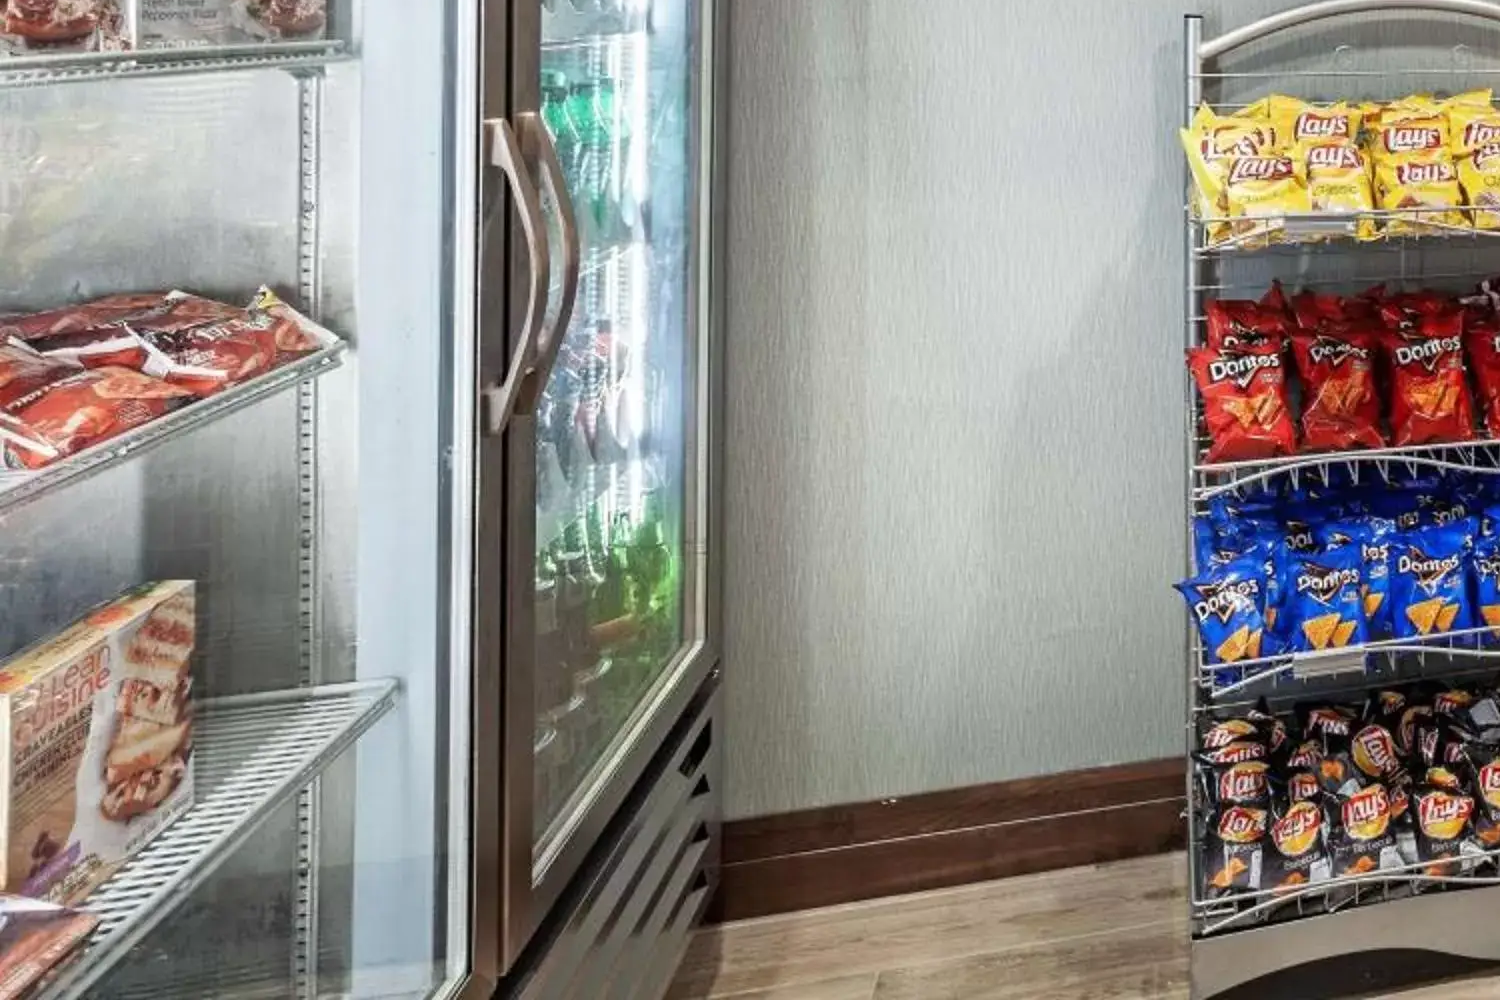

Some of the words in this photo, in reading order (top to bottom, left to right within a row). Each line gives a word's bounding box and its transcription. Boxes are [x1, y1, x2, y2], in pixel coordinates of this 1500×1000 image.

[1297, 112, 1348, 139] Lay's
[1388, 127, 1438, 151] Lay's
[1230, 157, 1291, 184] Lay's
[1309, 147, 1358, 168] ay's
[1396, 336, 1461, 364] Doritos
[1209, 353, 1280, 382] Doritos
[1399, 554, 1459, 574] Doritos
[1298, 569, 1360, 592] Doritos
[1348, 792, 1387, 827] Lay's
